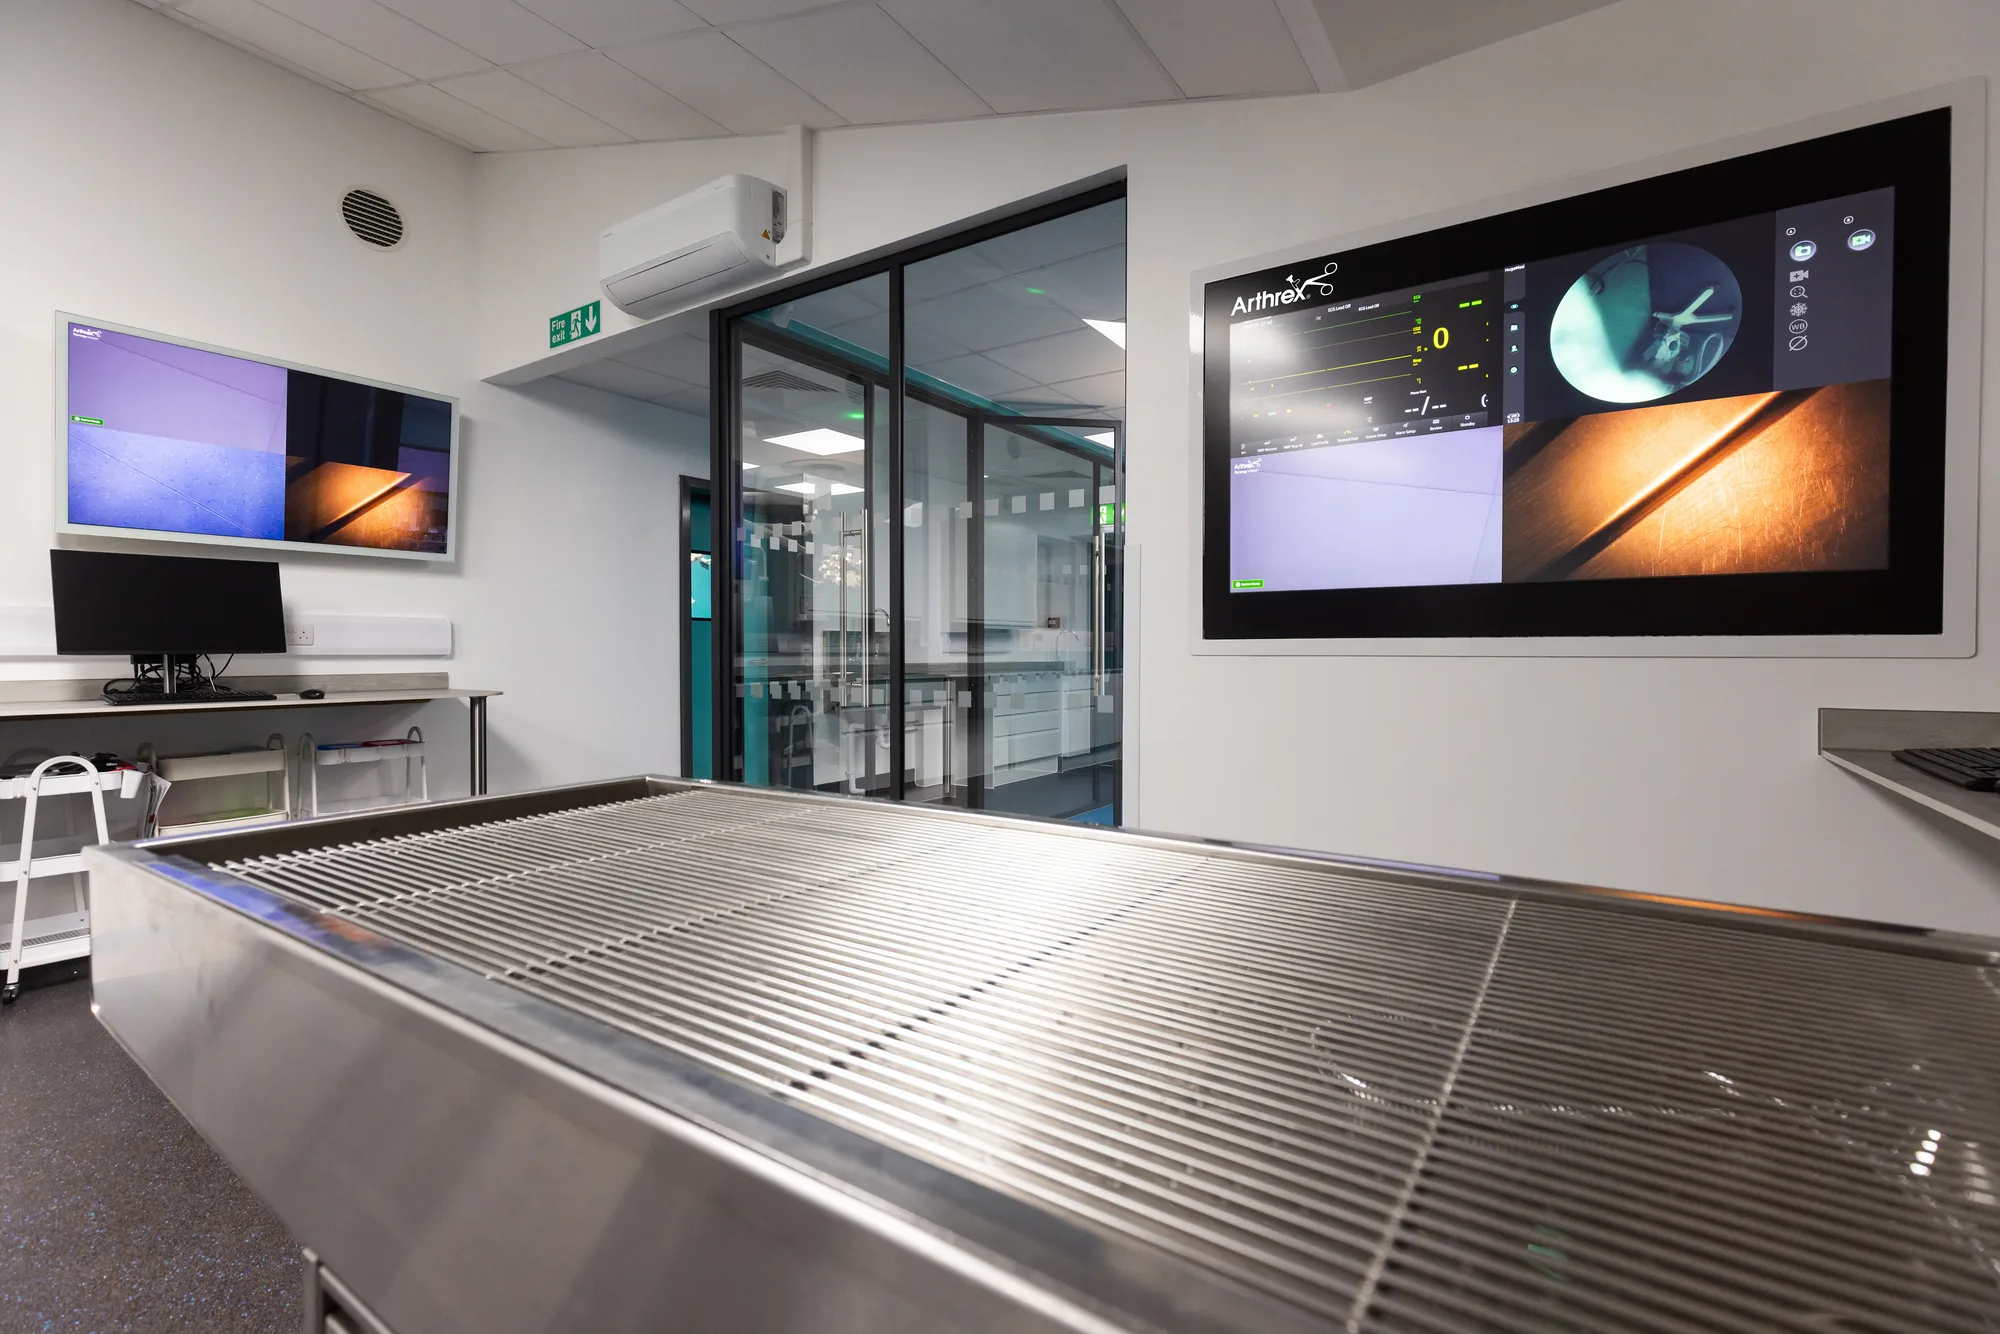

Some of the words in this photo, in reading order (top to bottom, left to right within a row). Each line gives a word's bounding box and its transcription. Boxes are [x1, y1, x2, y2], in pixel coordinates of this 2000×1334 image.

[1231, 284, 1306, 316] Arthrex
[552, 319, 565, 331] Fire
[552, 330, 565, 343] exit
